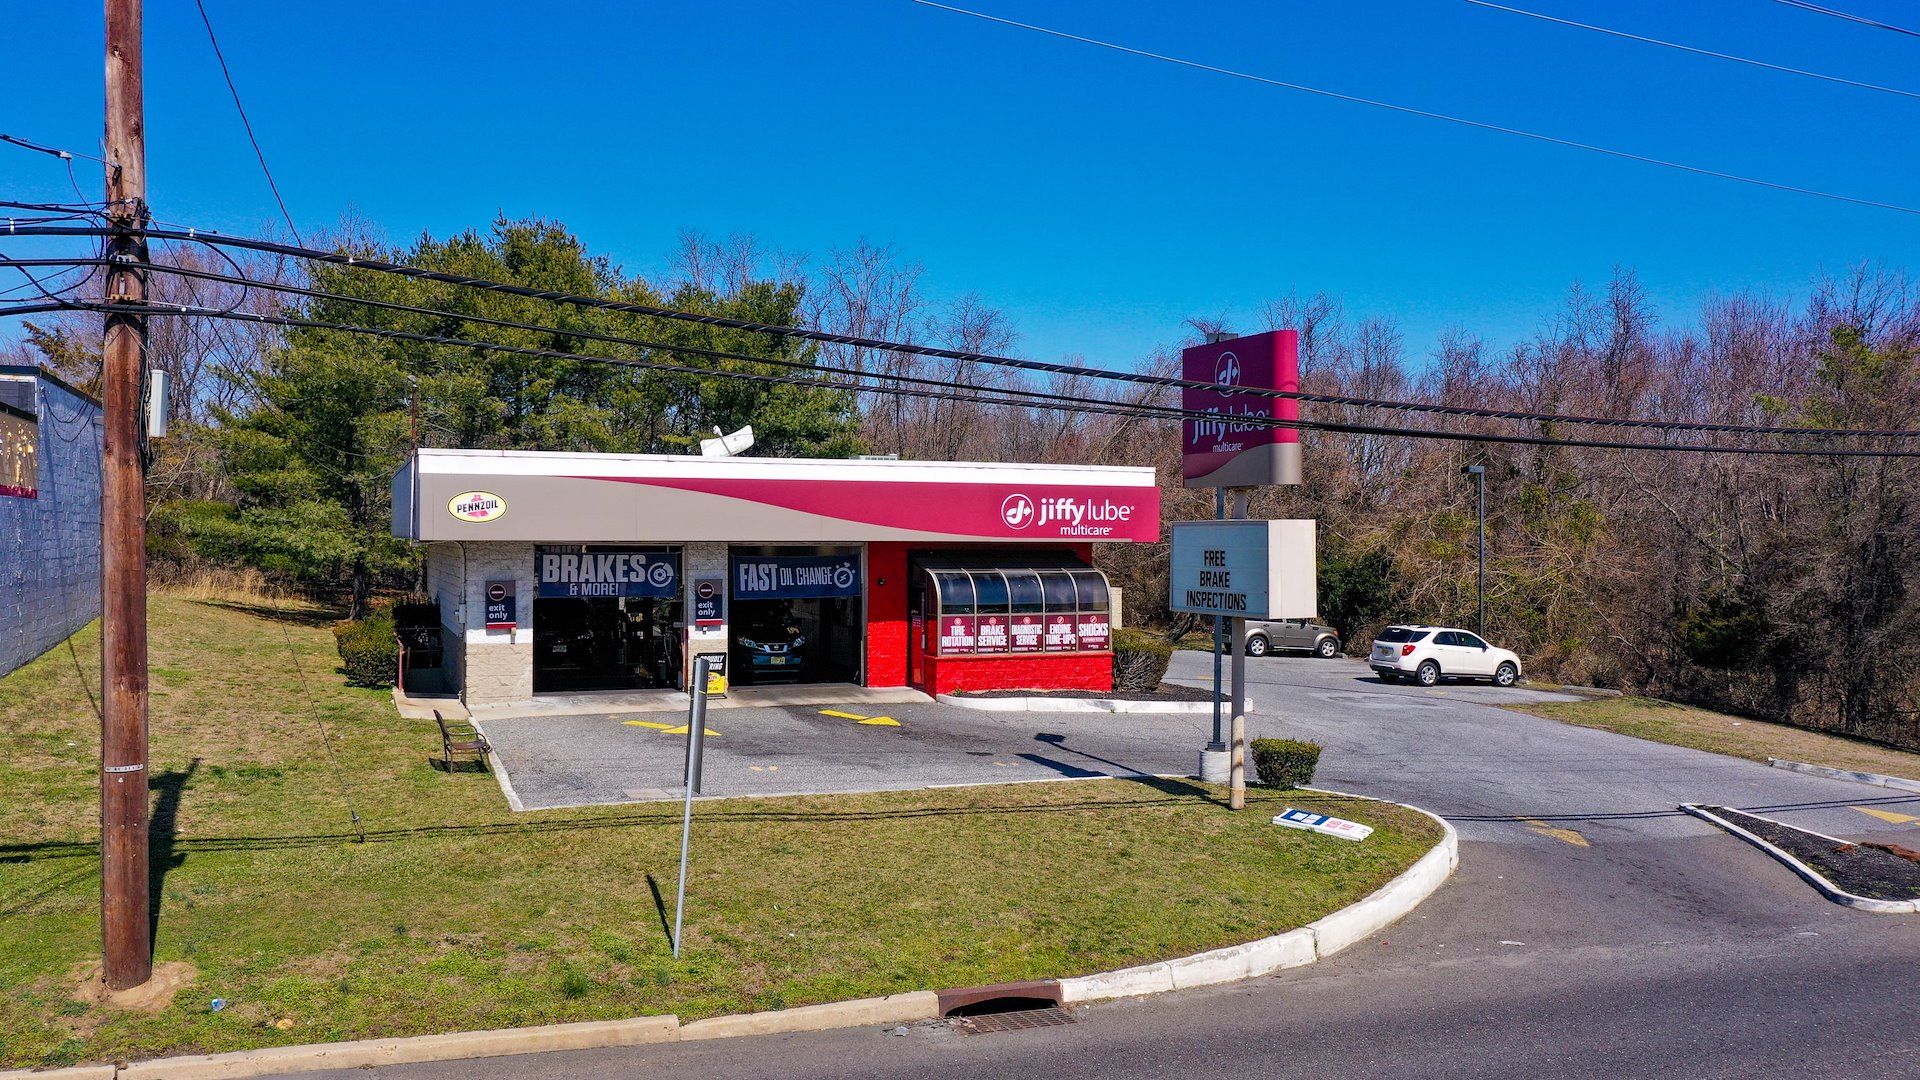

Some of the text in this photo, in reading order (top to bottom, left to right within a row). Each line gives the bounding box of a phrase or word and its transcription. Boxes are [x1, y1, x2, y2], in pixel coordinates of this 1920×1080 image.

[1212, 441, 1242, 453] multicare
[456, 499, 499, 513] PENNZOIL
[1038, 498, 1131, 526] jiffy lube
[1060, 525, 1110, 536] multicare
[1204, 550, 1226, 567] FREE
[542, 554, 647, 583] BRAKES
[739, 563, 833, 592] FAST OIL CHANGE
[1200, 571, 1230, 588] BRAKE
[569, 582, 619, 596] & MORE!
[698, 601, 713, 609] exit
[1186, 590, 1247, 611] INSPECTIONS
[488, 603, 505, 612] exit
[698, 608, 715, 617] only
[488, 611, 508, 620] only
[950, 625, 966, 636] TIRE
[980, 625, 1005, 636] BRAKE
[1011, 624, 1043, 635] DIAGNOSTIC
[1049, 623, 1072, 634] ENGINE
[1078, 622, 1109, 637] SHOCKS
[941, 635, 974, 647] ROTATION
[978, 635, 1007, 647] SERVICE
[1016, 634, 1038, 646] SERVICE
[1045, 633, 1076, 645] TUNE-UPS
